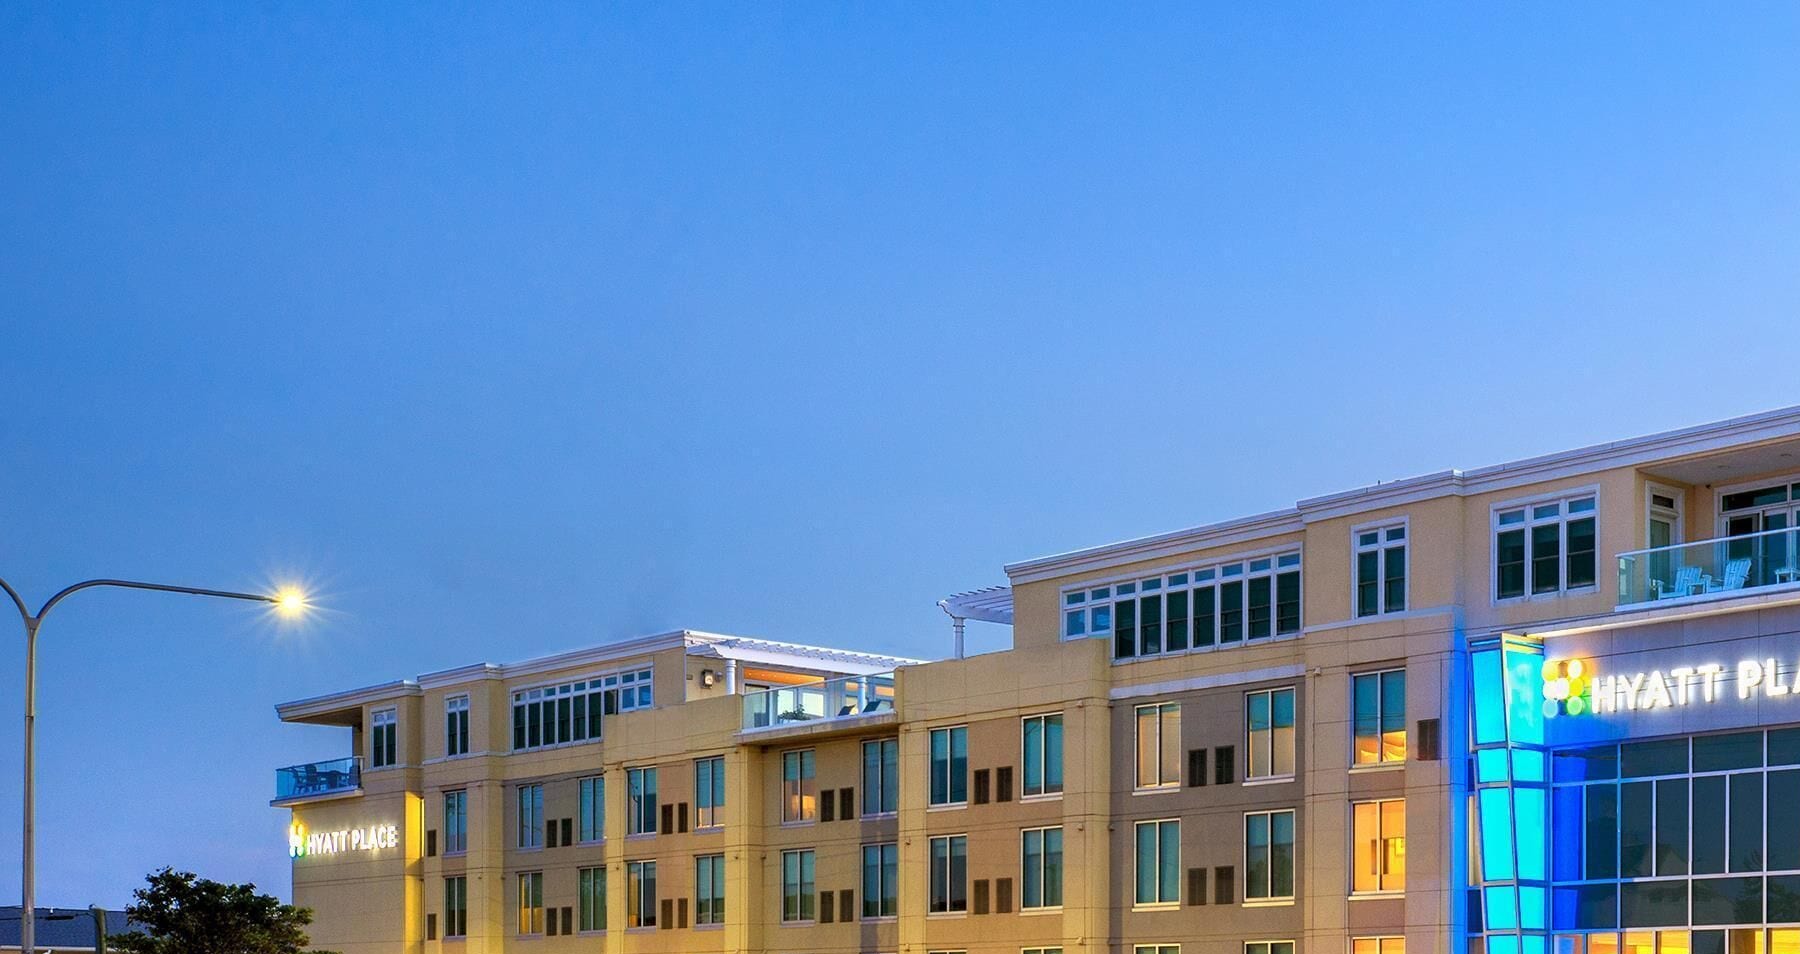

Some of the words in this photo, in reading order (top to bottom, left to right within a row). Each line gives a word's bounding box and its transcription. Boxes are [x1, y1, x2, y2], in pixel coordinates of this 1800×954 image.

[1591, 664, 1721, 714] HYATT
[307, 830, 347, 855] HYATT
[351, 825, 398, 850] PLACE
